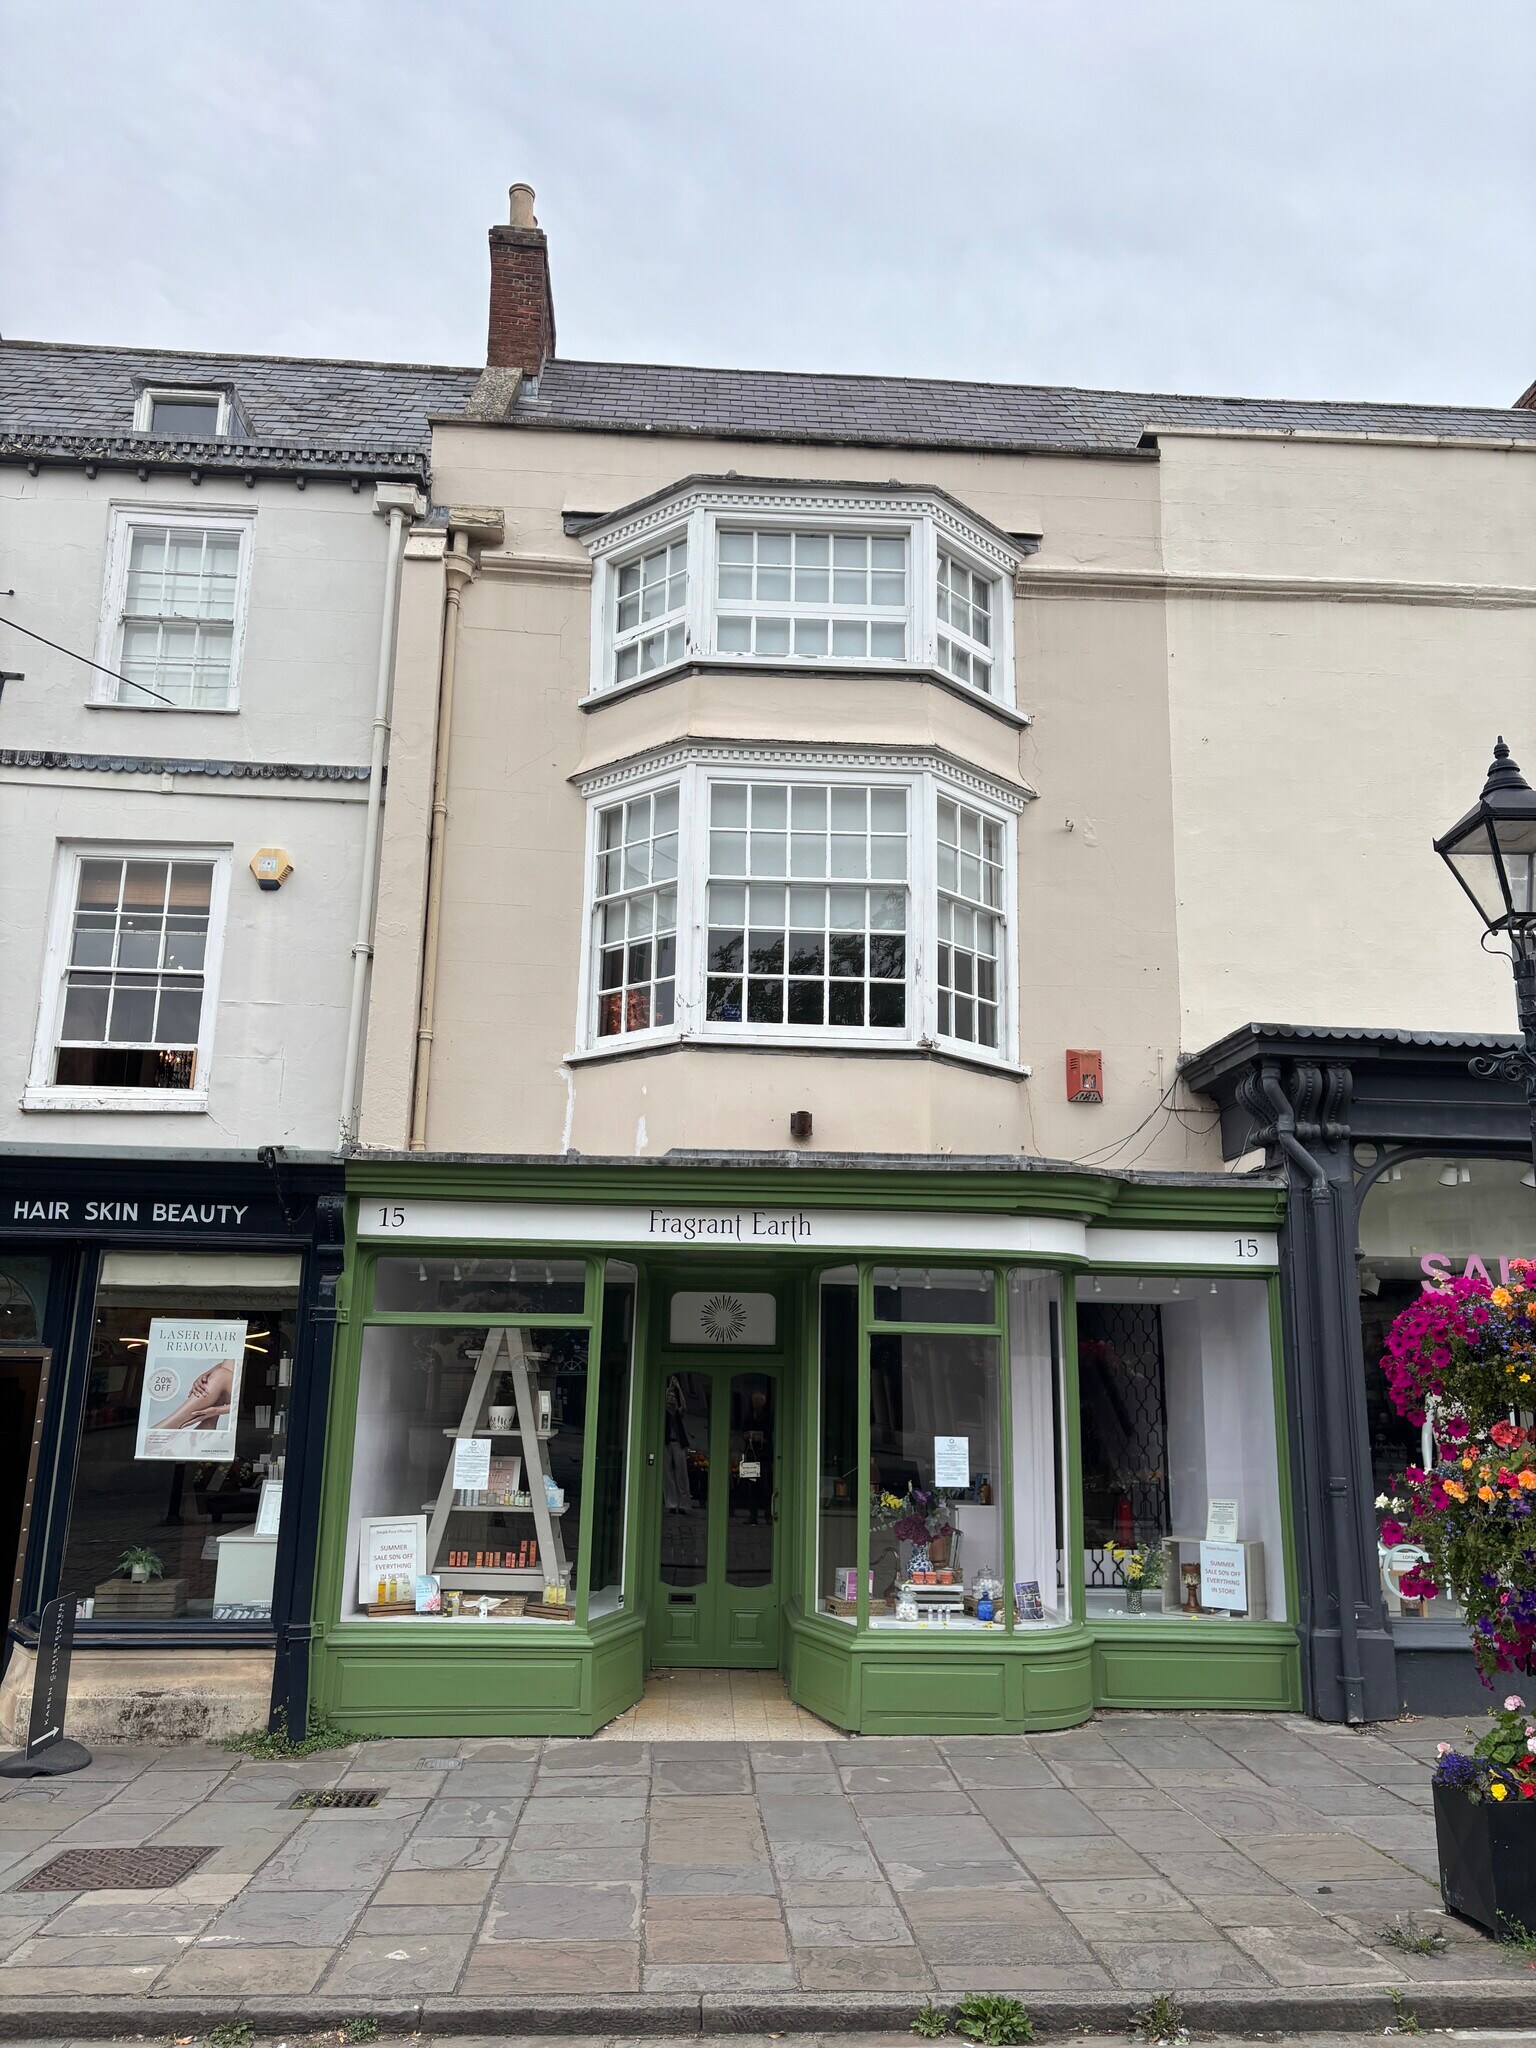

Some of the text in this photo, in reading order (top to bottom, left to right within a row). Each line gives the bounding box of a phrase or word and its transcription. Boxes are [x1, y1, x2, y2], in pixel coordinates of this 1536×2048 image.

[13, 1200, 249, 1224] HAIR SKIN BEAUTY
[378, 1207, 405, 1227] 15
[649, 1209, 812, 1243] Fragrant Earth
[1234, 1239, 1258, 1258] 15
[160, 1329, 237, 1341] LASER HAIR
[166, 1341, 228, 1352] REMOVAL
[155, 1376, 172, 1384] 20%
[154, 1384, 171, 1392] OFF
[380, 1544, 408, 1552] SUMMER
[375, 1562, 412, 1571] EVERYTHING
[1210, 1560, 1235, 1569] SUMMER
[1204, 1568, 1218, 1576] SALE
[1218, 1569, 1230, 1577] 50%
[1206, 1577, 1240, 1586] EVERYTHING
[1218, 1587, 1236, 1595] STORE
[44, 1687, 52, 1726] KAREN
